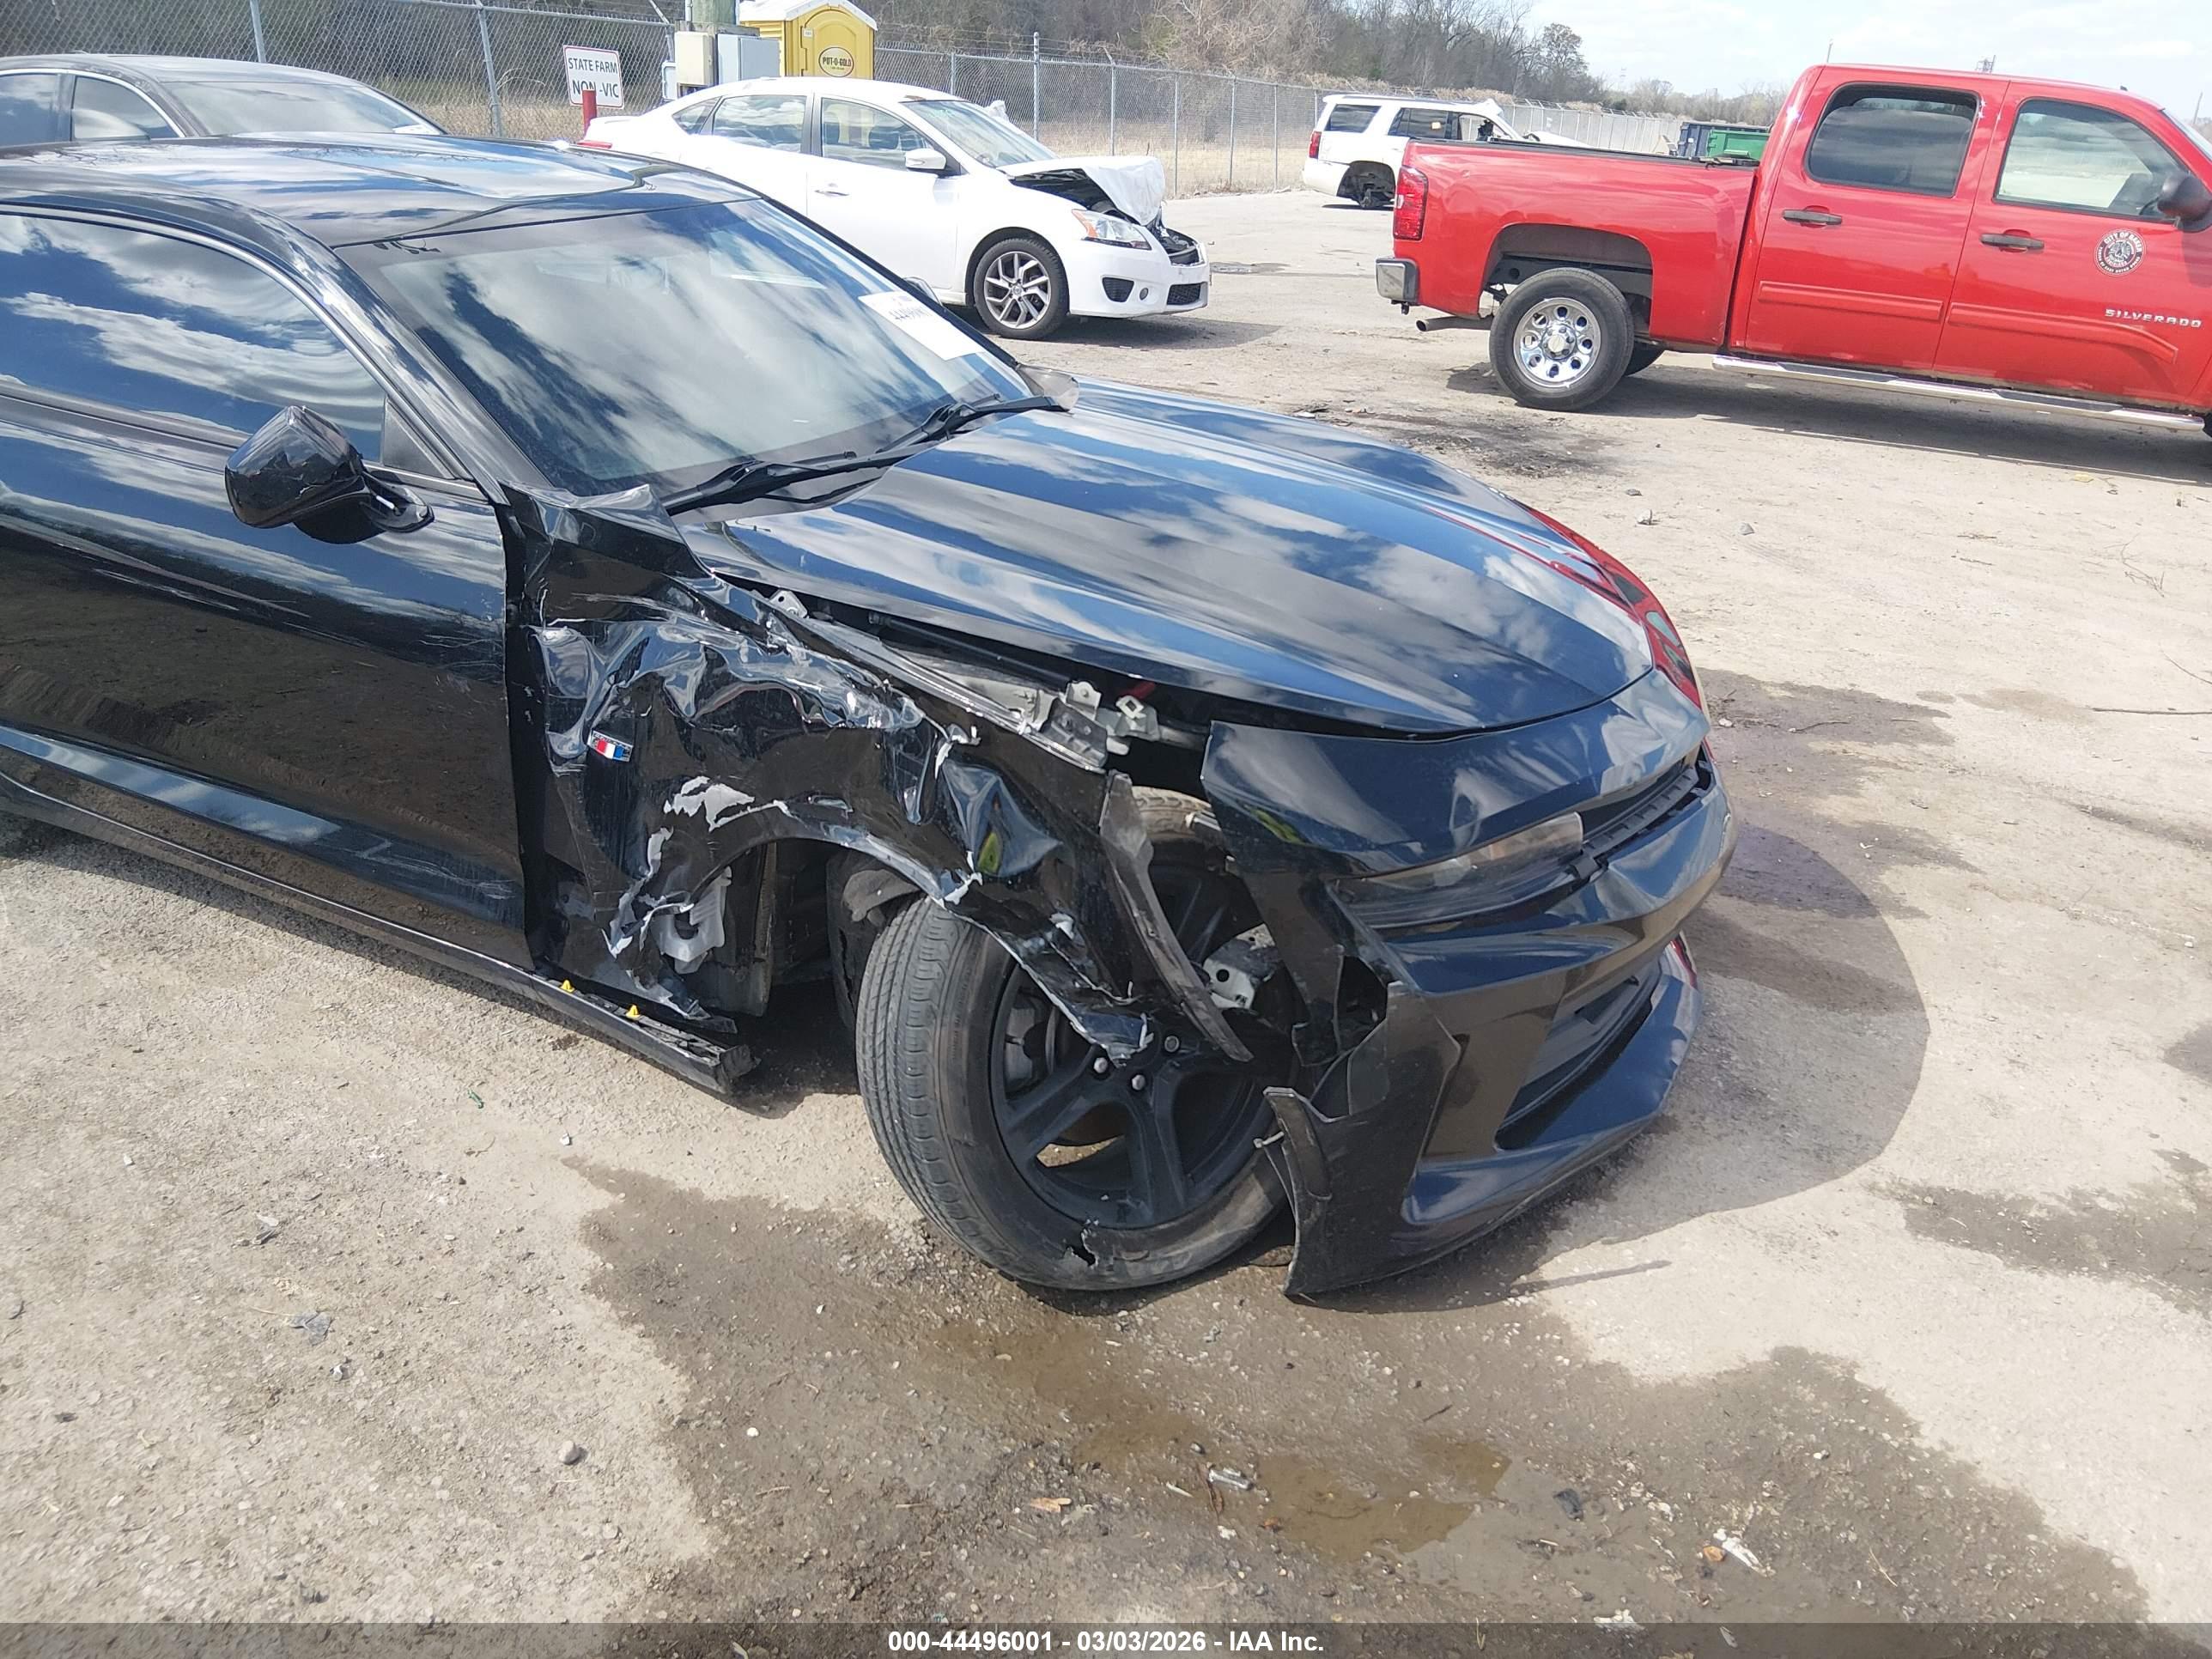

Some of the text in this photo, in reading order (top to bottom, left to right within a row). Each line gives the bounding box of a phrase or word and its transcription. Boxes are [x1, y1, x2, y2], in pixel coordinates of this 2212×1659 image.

[568, 58, 618, 74] STATE FARM
[2103, 233, 2118, 244] CITY
[2105, 308, 2202, 328] SILVERADO
